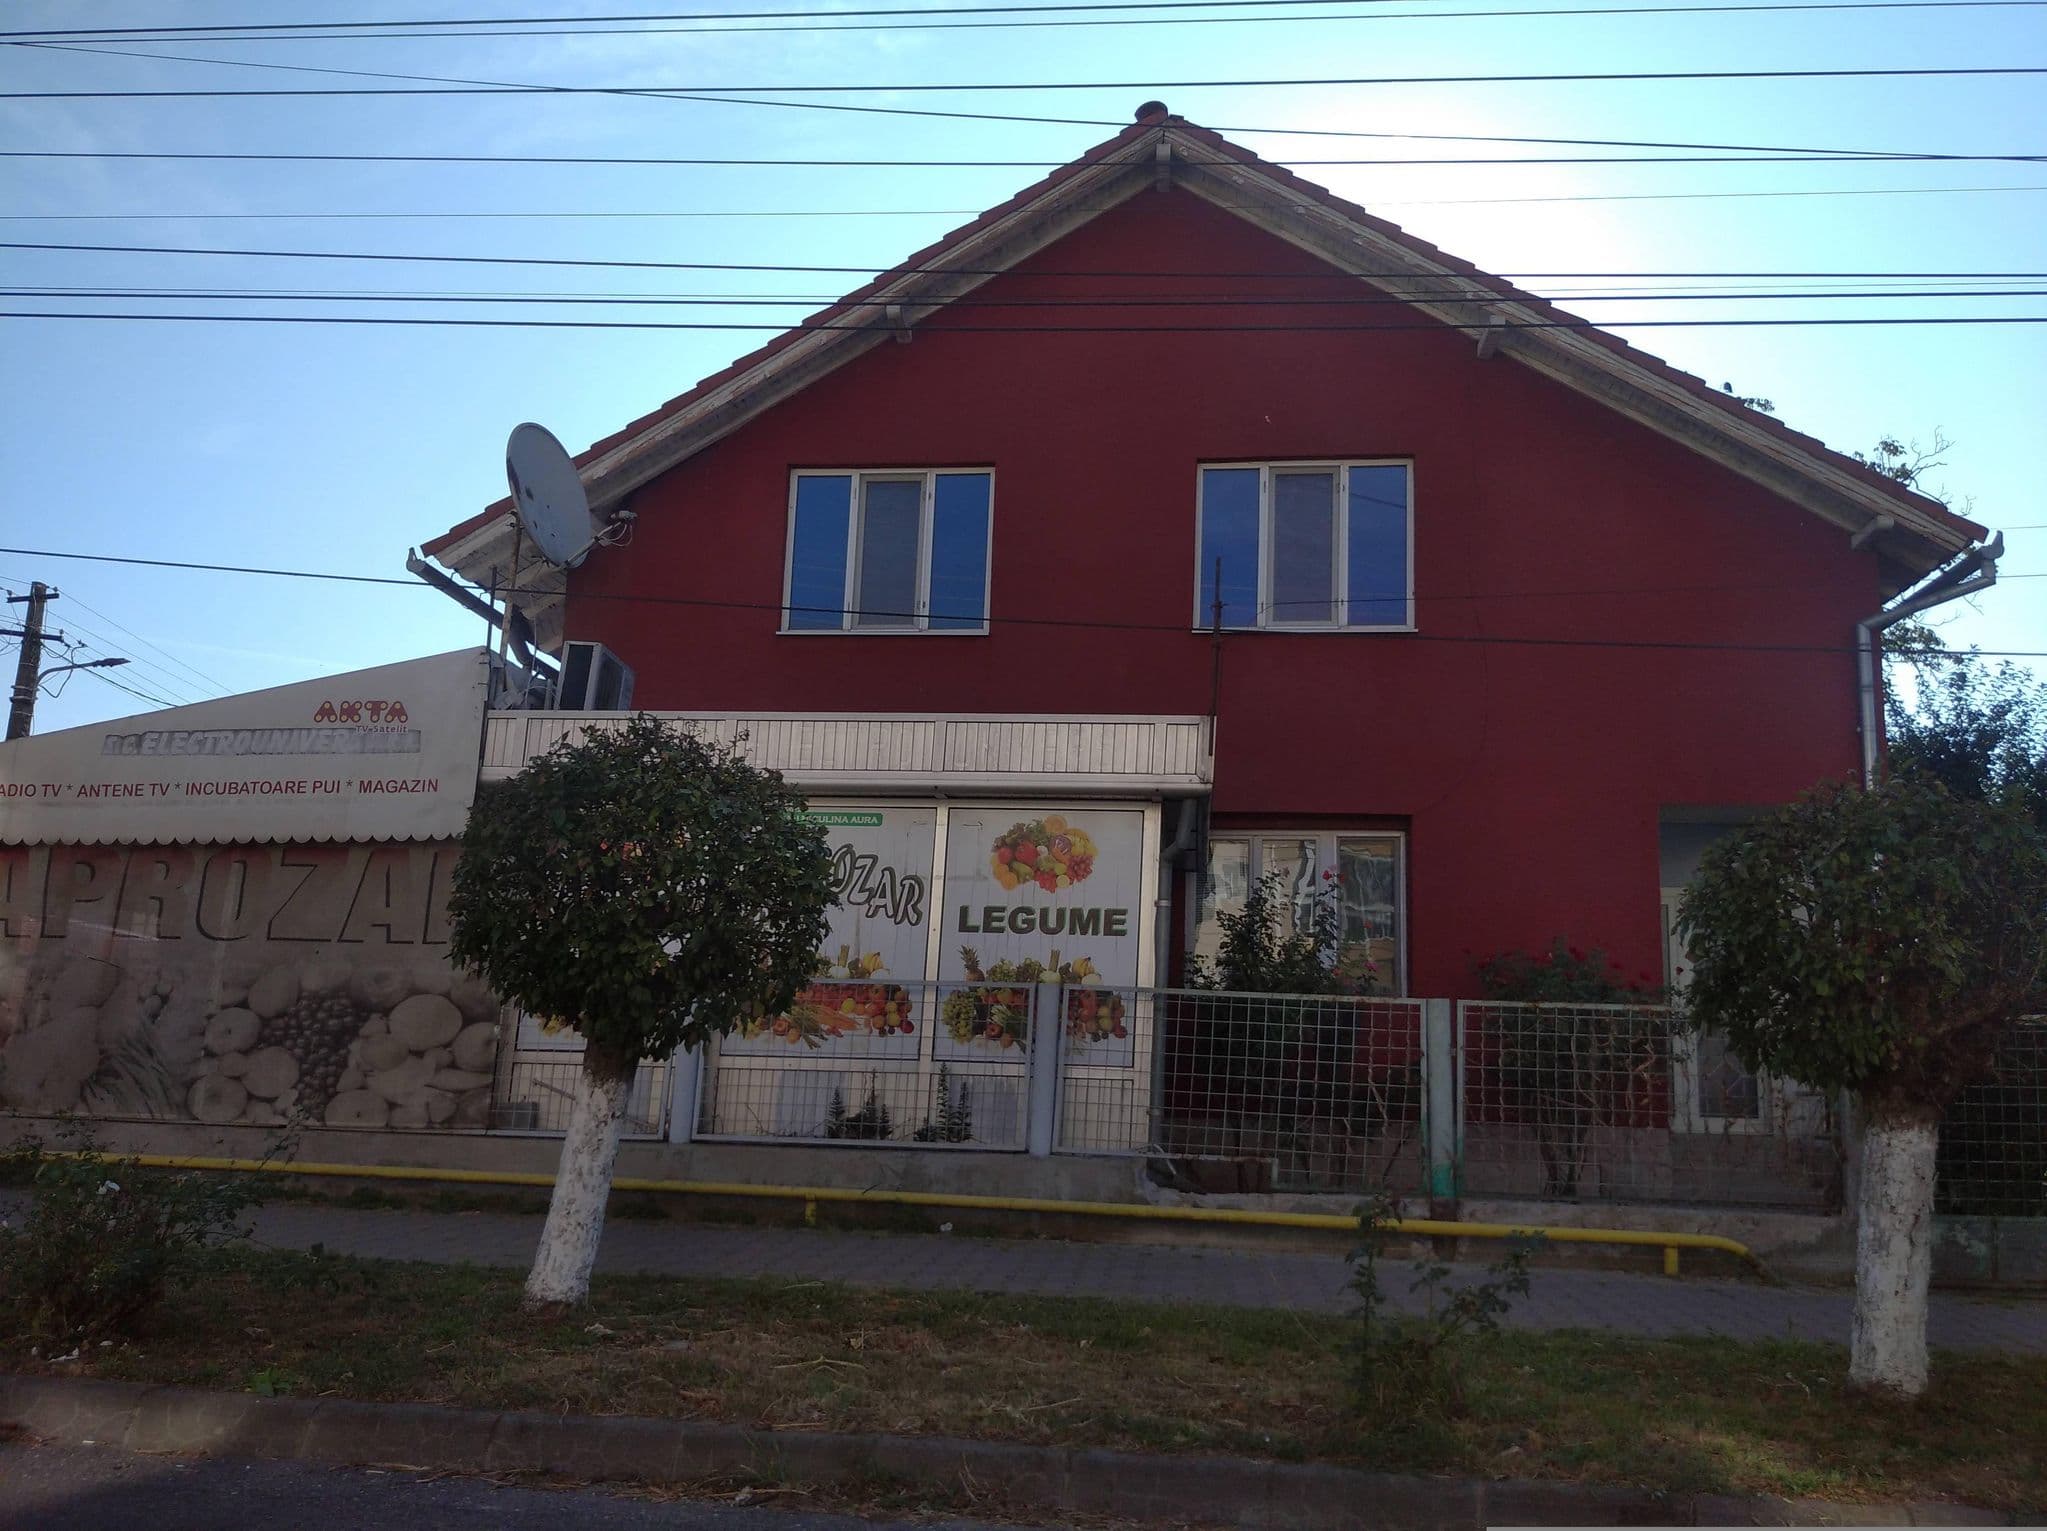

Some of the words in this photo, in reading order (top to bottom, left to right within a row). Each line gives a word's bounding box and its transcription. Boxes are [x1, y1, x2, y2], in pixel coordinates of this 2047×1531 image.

[313, 700, 408, 723] AKTA
[355, 724, 408, 734] TV-Satelit
[41, 783, 62, 798] TV
[77, 783, 145, 797] ANTENE
[149, 782, 171, 797] TV
[185, 780, 307, 796] INCUBATOARE
[312, 780, 341, 794] PUI
[358, 778, 439, 794] MAGAZIN
[850, 816, 878, 824] AURA
[830, 842, 925, 926] OZAR
[958, 904, 1129, 938] LEGUME
